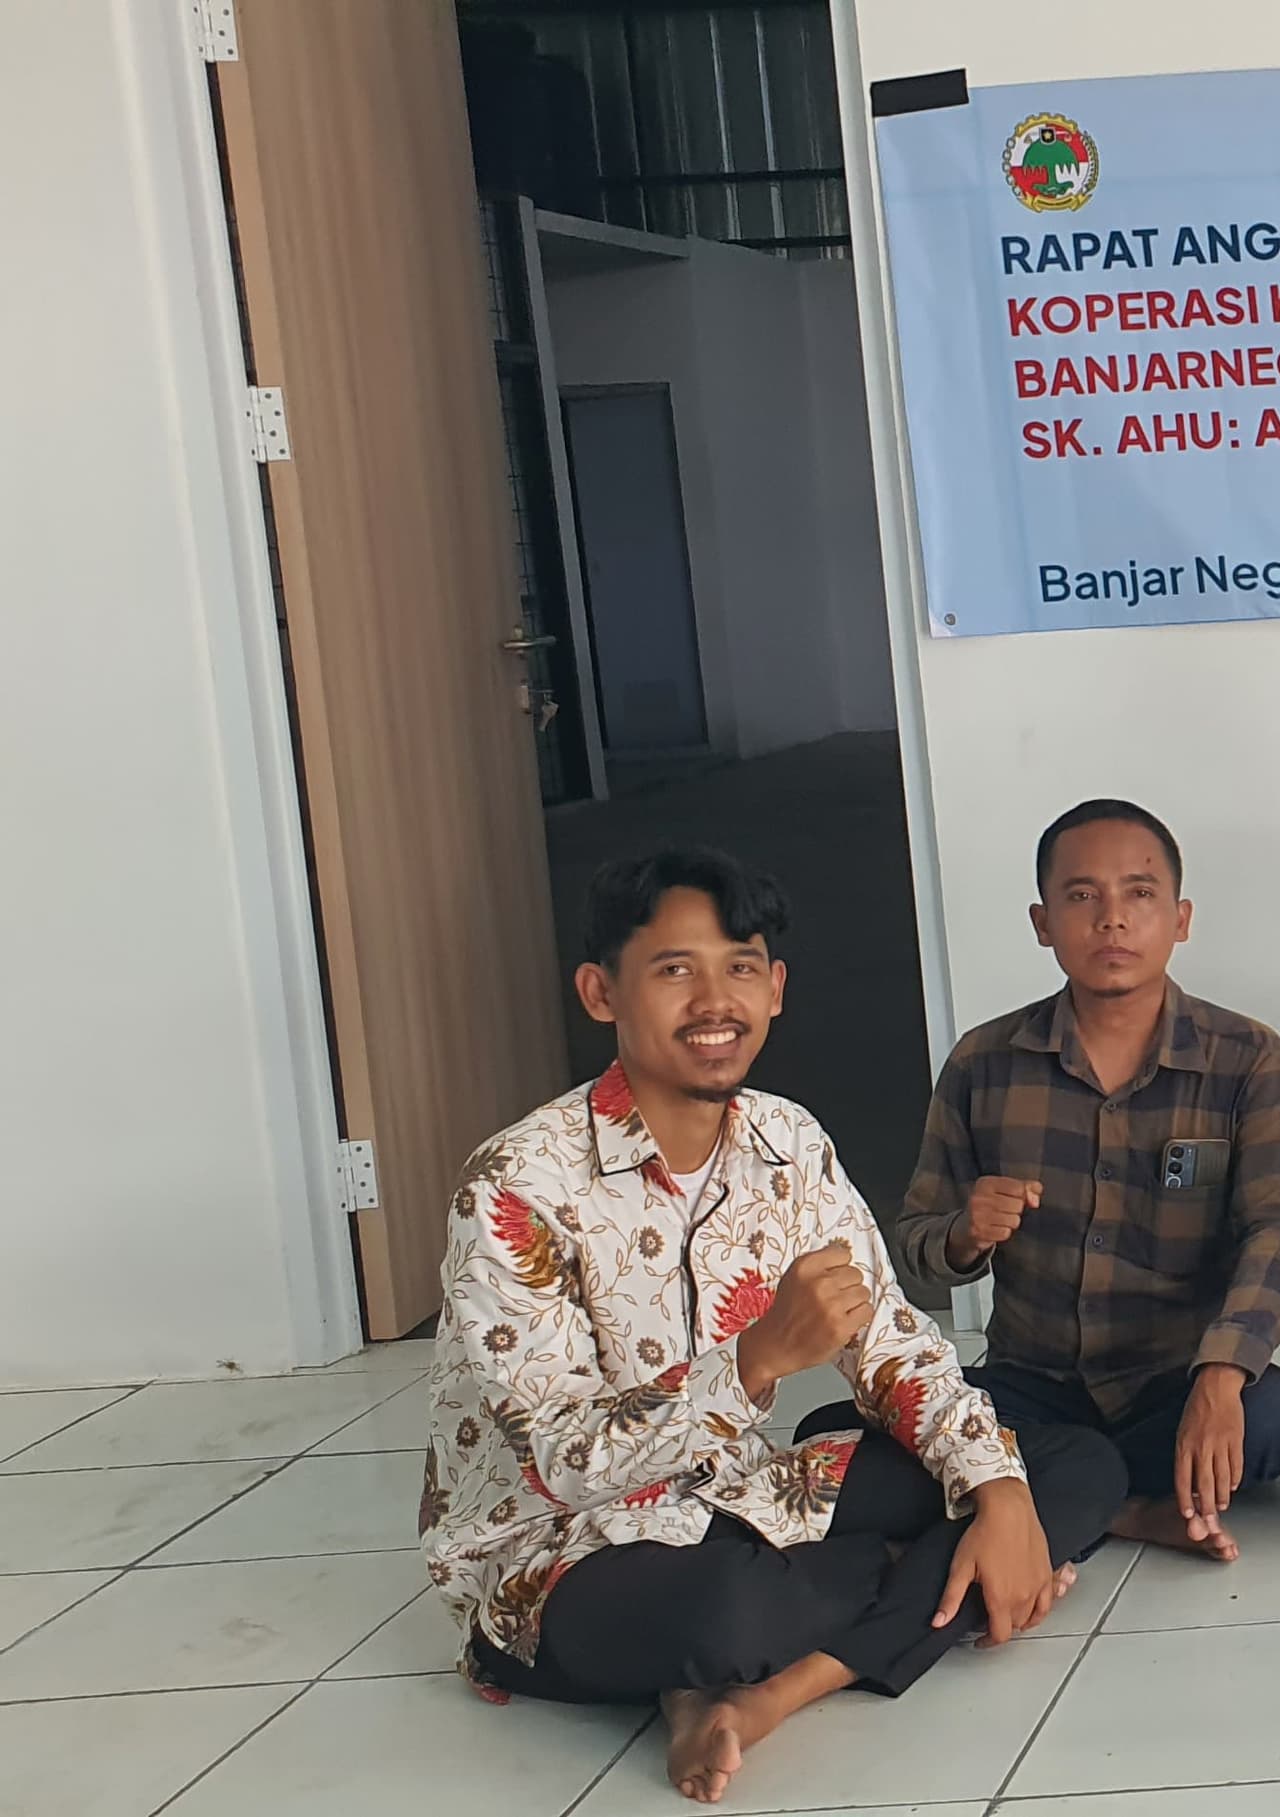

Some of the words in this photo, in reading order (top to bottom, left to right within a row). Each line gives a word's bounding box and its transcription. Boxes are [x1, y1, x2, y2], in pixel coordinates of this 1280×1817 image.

[1001, 228, 1159, 275] RAPAT
[1007, 284, 1259, 337] KOPERASI
[1021, 418, 1102, 459] SK.
[1116, 410, 1241, 455] AHU:
[1038, 556, 1185, 607] Banjar
